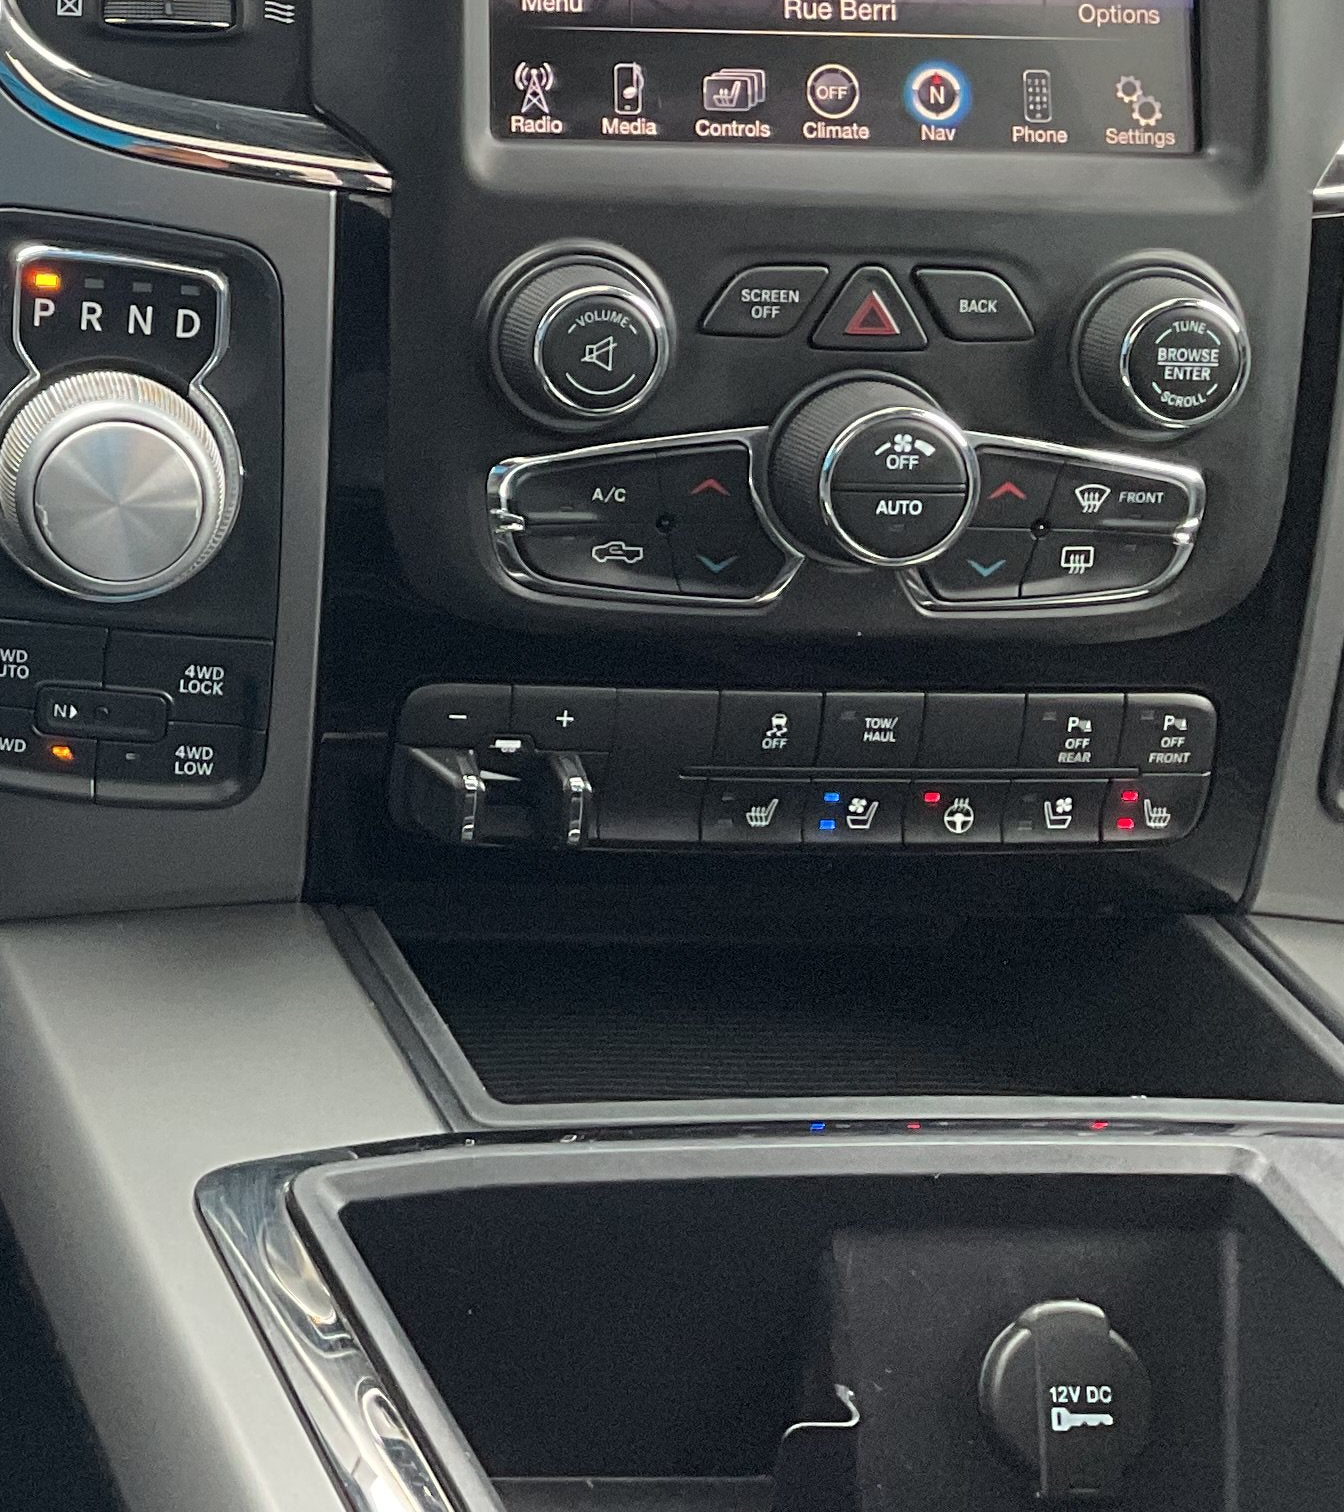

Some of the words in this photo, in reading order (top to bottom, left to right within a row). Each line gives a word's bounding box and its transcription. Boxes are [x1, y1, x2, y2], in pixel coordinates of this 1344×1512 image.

[1078, 3, 1161, 28] Options
[816, 85, 848, 100] OFF
[511, 116, 563, 134] Radio
[601, 118, 657, 136] Media
[694, 119, 771, 139] Controls
[802, 121, 870, 140] Climate
[920, 126, 956, 141] Nav
[1012, 126, 1068, 143] Phone
[1106, 128, 1176, 149] Settings
[741, 289, 800, 304] SCREEN
[751, 305, 781, 319] OFF
[959, 299, 997, 313] BACK
[34, 298, 55, 327] P
[78, 302, 104, 332] R
[128, 306, 153, 335] N
[175, 309, 201, 339] D
[576, 309, 630, 328] VOLUME
[1173, 320, 1206, 335] TUNE
[1157, 347, 1219, 363] BROWSE
[1163, 365, 1211, 382] ENTER
[1160, 392, 1206, 407] SCROLL
[886, 455, 919, 470] OFF
[591, 488, 627, 503] A/C
[1118, 491, 1164, 504] FRONT
[876, 500, 922, 516] AUTO
[184, 665, 224, 681] 4WD
[179, 679, 223, 696] LOCK
[53, 705, 67, 719] N
[864, 717, 899, 731] TOW/
[761, 738, 789, 749] OFF
[863, 731, 897, 743] HAUL
[1064, 738, 1091, 749] OFF
[1160, 736, 1185, 748] OFF
[175, 746, 213, 762] 4WD
[1057, 752, 1091, 764] REAR
[1148, 752, 1190, 764] FRONT
[174, 762, 213, 778] LOW
[1049, 1386, 1080, 1403] 12V
[1086, 1386, 1112, 1403] DC
